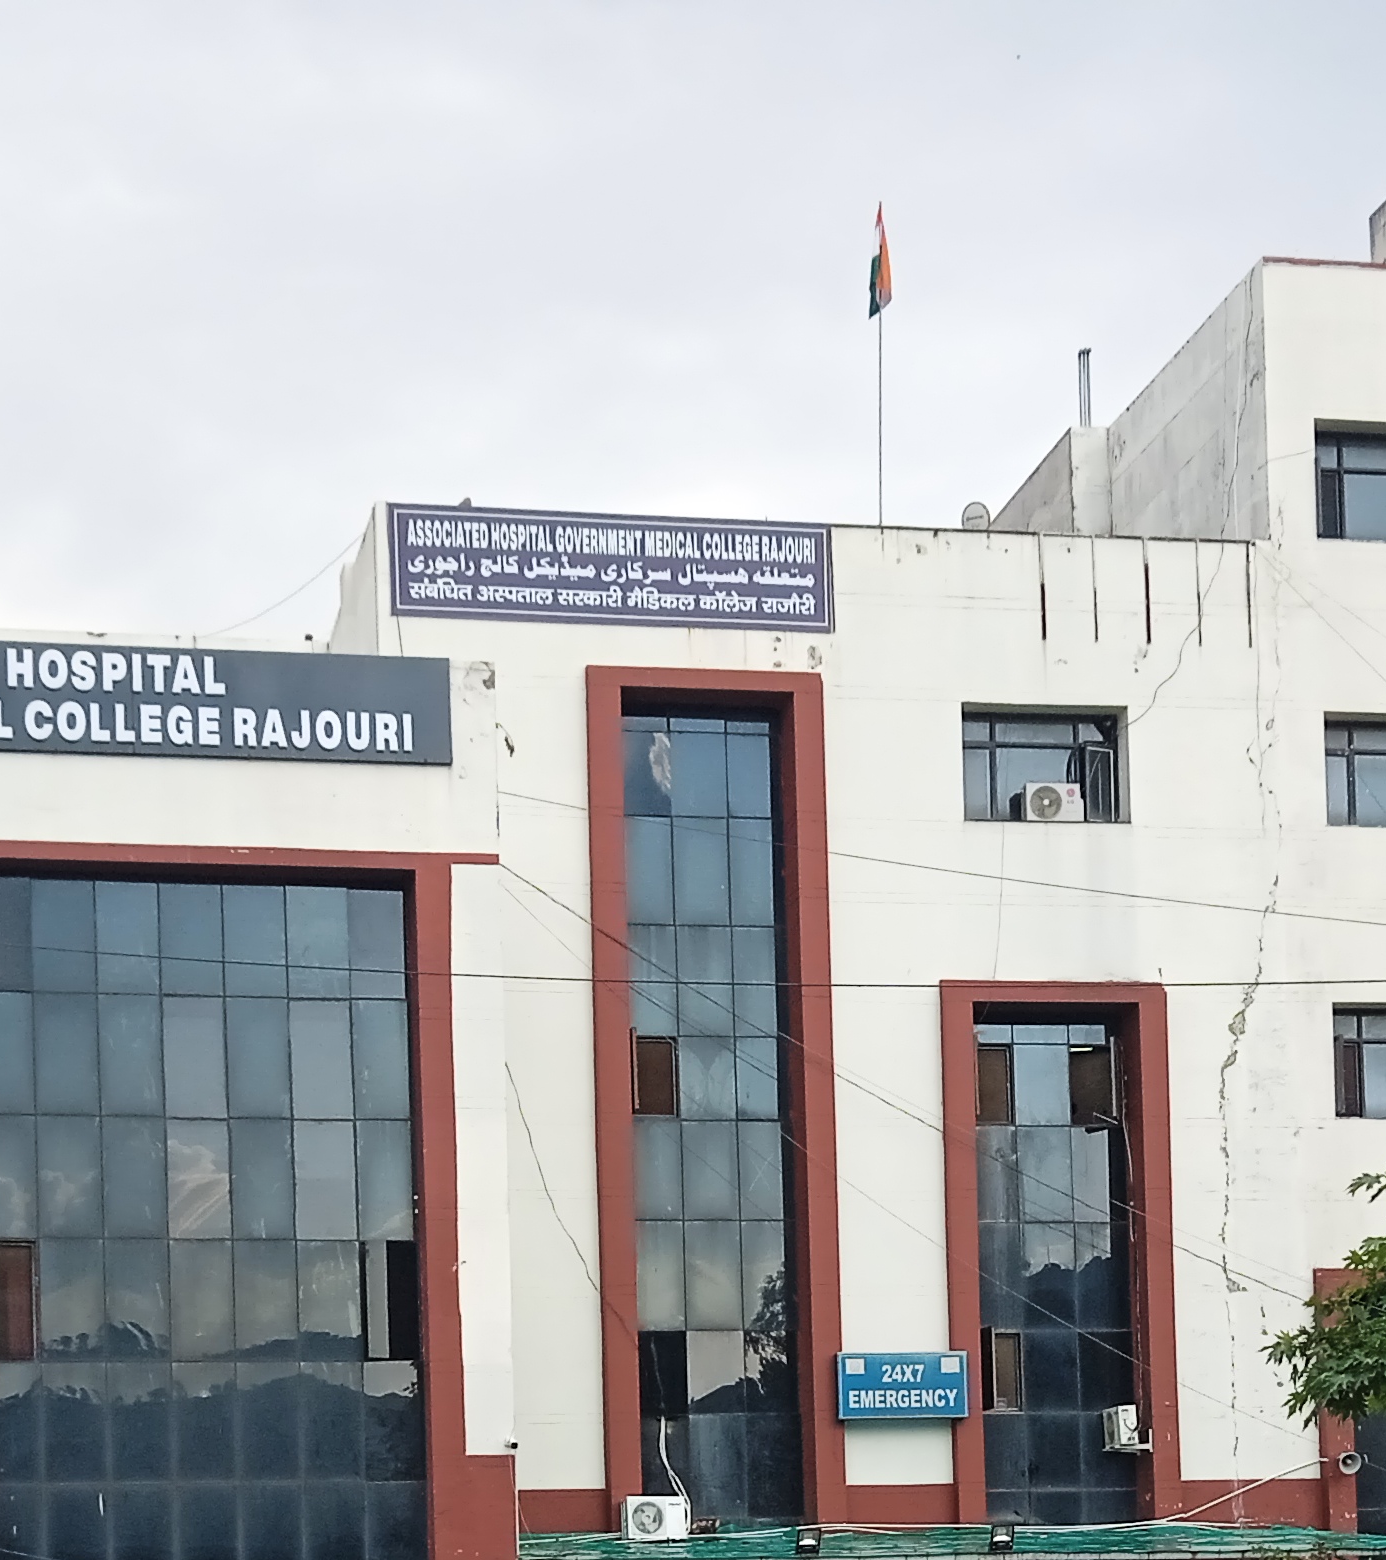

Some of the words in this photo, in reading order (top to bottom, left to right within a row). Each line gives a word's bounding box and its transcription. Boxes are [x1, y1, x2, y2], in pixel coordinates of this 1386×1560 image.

[407, 518, 489, 549] ASSOCIATED
[491, 522, 554, 553] HOSPITAL
[555, 526, 643, 557] GOVERNMENT
[644, 531, 701, 560] MEDICAL
[702, 532, 760, 562] COLLEGE
[762, 535, 815, 564] RAJOURI
[476, 584, 555, 605] अस्पताल
[557, 585, 623, 608] सरकारी
[699, 590, 758, 613] कॉलेज
[6, 647, 227, 696] HOSPITAL
[24, 699, 221, 747] COLLEGE
[233, 707, 414, 753] RAJOURI
[881, 1364, 925, 1383] 24X7
[848, 1389, 958, 1408] EMERGENCY
